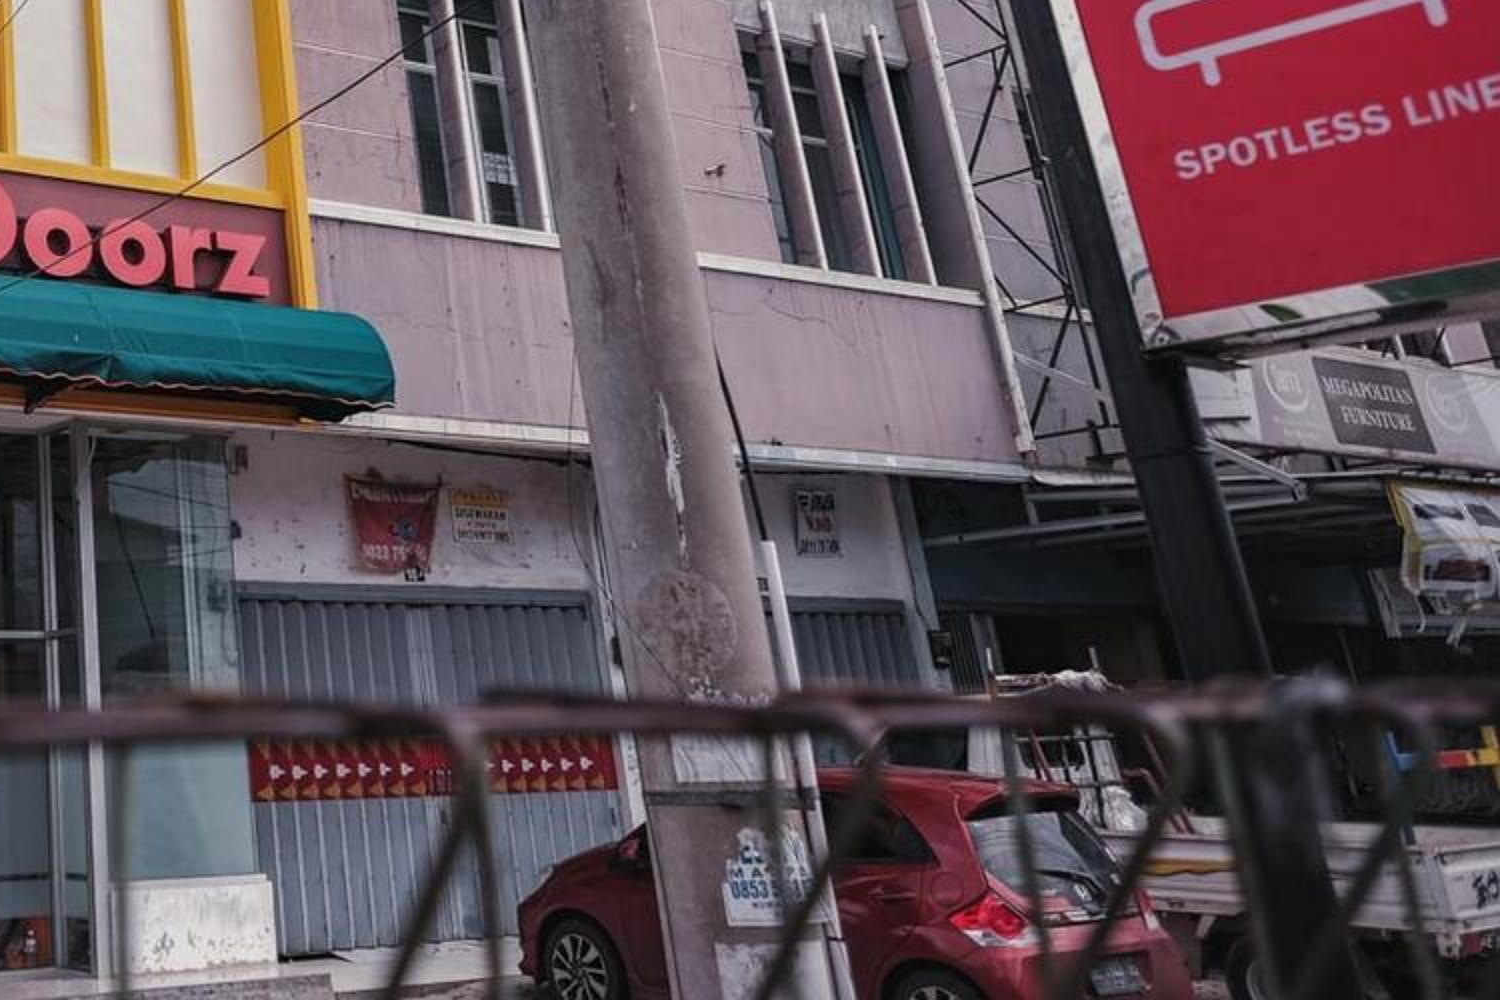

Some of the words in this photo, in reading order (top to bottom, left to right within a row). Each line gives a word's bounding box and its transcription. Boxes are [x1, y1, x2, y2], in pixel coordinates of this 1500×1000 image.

[1174, 103, 1392, 180] SPOTLESS
[1321, 376, 1413, 404] MEGAPOLITAN
[1340, 406, 1417, 431] FURNITURE
